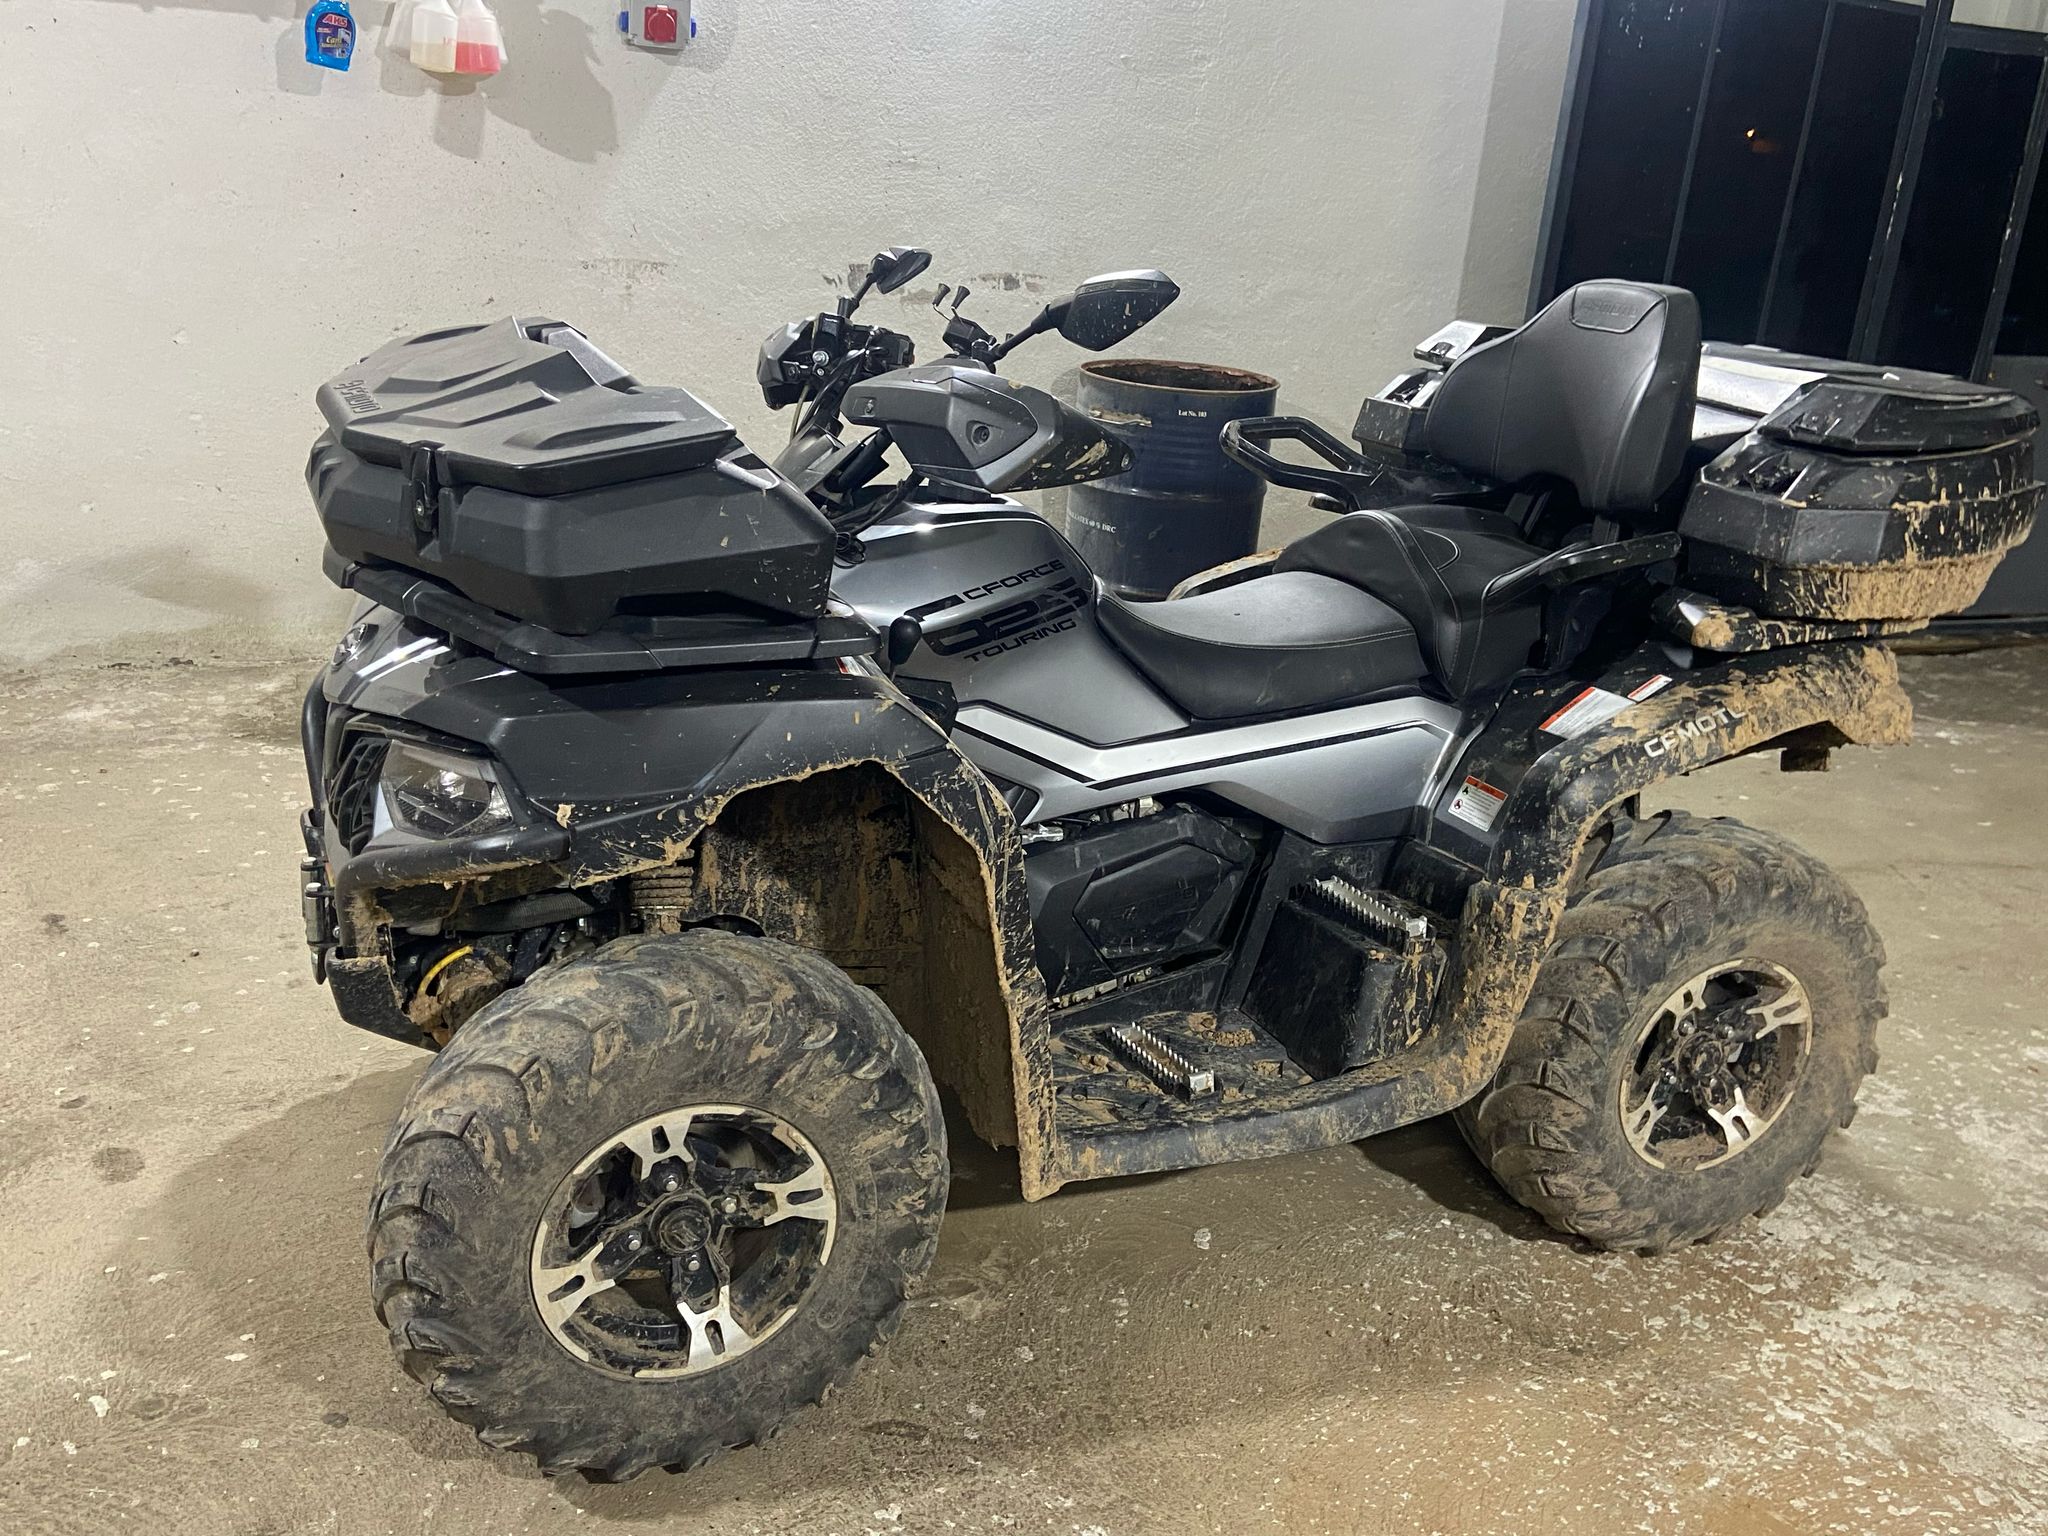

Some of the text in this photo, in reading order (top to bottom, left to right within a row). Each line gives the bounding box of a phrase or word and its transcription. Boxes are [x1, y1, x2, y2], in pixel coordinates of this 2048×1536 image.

[1101, 523, 1117, 534] DRC
[962, 559, 1066, 601] CFORCE
[963, 618, 1077, 663] TOURING
